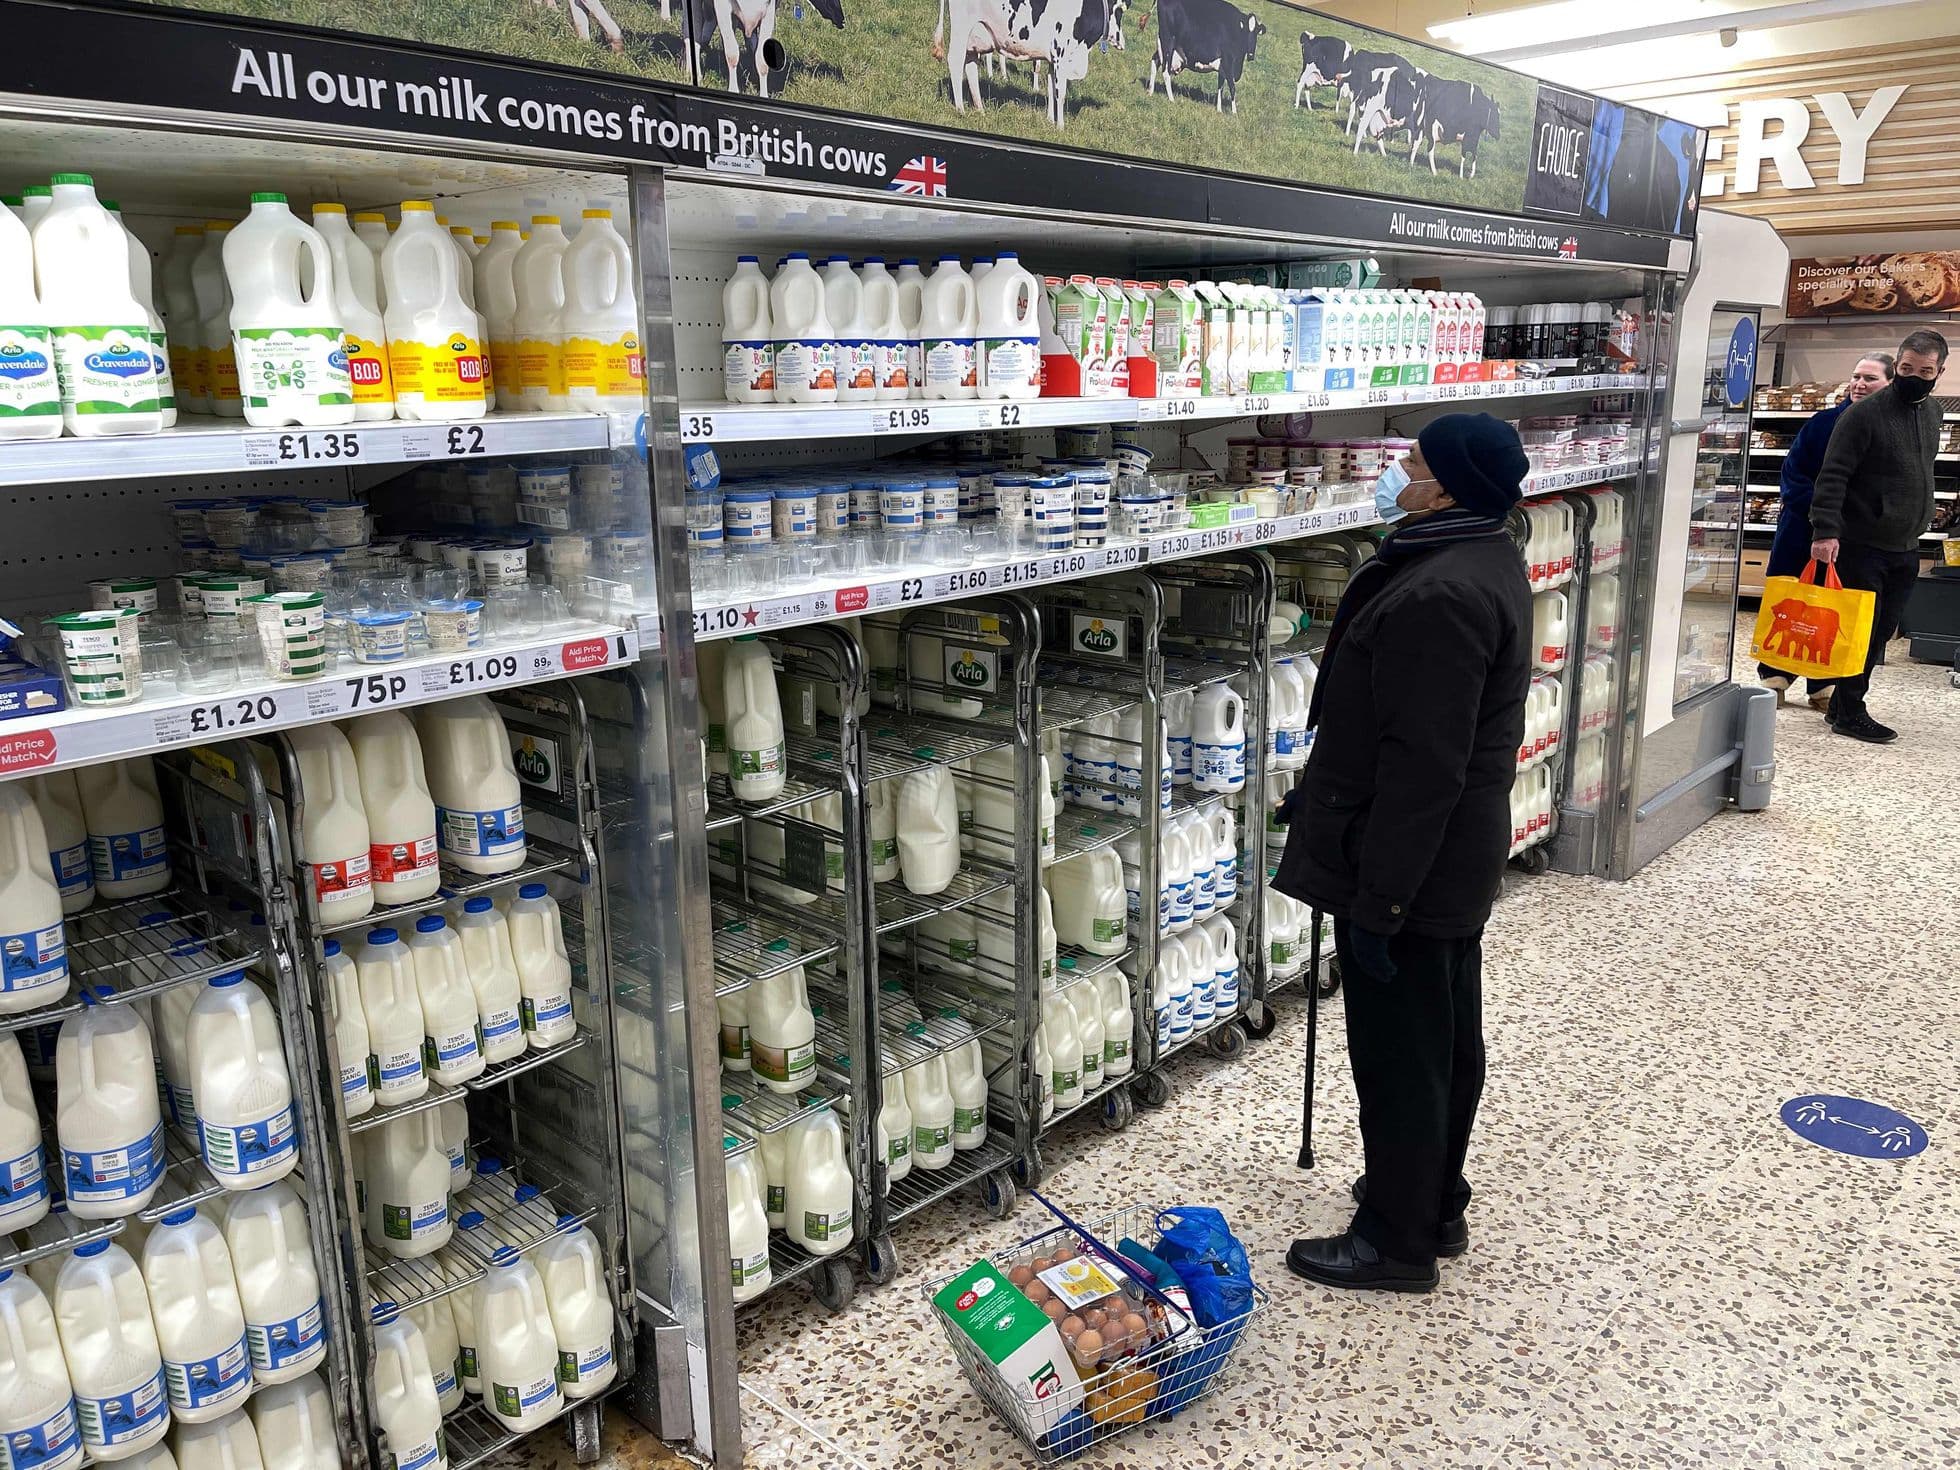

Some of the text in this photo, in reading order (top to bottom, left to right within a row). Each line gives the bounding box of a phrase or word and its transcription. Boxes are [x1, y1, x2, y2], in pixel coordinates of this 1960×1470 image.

[231, 48, 887, 177] All our milk comes from British cows
[1536, 122, 1584, 179] CHOICE
[1390, 212, 1559, 251] All our milk comes from British cows
[1798, 265, 1852, 278] Discover
[1854, 264, 1877, 275] our
[1797, 277, 1894, 291] speciality range
[89, 356, 150, 370] Cravendale
[1368, 391, 1388, 403] £1.65
[1440, 387, 1457, 398] £1.65
[1465, 385, 1481, 396] £1.80
[1167, 401, 1195, 416] £1.40
[1245, 398, 1269, 411] £1.20
[1308, 394, 1330, 408] £1.65
[889, 409, 930, 428] £1.95
[1001, 405, 1020, 426] £2
[279, 434, 360, 460] £1.35
[448, 426, 486, 455] £2
[1542, 477, 1556, 489] £1.10
[1300, 516, 1322, 530] £2.05
[1337, 510, 1359, 525] £1.10
[1256, 522, 1276, 541] 88p
[1162, 537, 1189, 554] £1.30
[1201, 532, 1227, 548] £1.15
[1106, 547, 1137, 565] £2.10
[1003, 562, 1038, 583] £1.15
[1053, 556, 1085, 575] £1.60
[950, 571, 987, 591] £1.60
[901, 578, 923, 601] £2
[782, 604, 801, 615] £1.15
[815, 600, 828, 610] 89p
[1083, 630, 1111, 648] Arla
[569, 644, 602, 656] Aldi Price
[534, 657, 551, 669] 89p
[575, 654, 597, 664] Match
[450, 656, 517, 685] £1.09
[955, 665, 983, 682] Arla
[346, 674, 406, 708] 75p
[191, 696, 277, 733] £1.20
[15, 739, 45, 750] Price
[1, 751, 38, 765] Match
[519, 756, 545, 776] Arla
[442, 1037, 471, 1050] ORGANIC
[448, 1034, 465, 1043] TESCO
[385, 1057, 416, 1070] ORGANIC
[391, 1053, 410, 1062] TESCO
